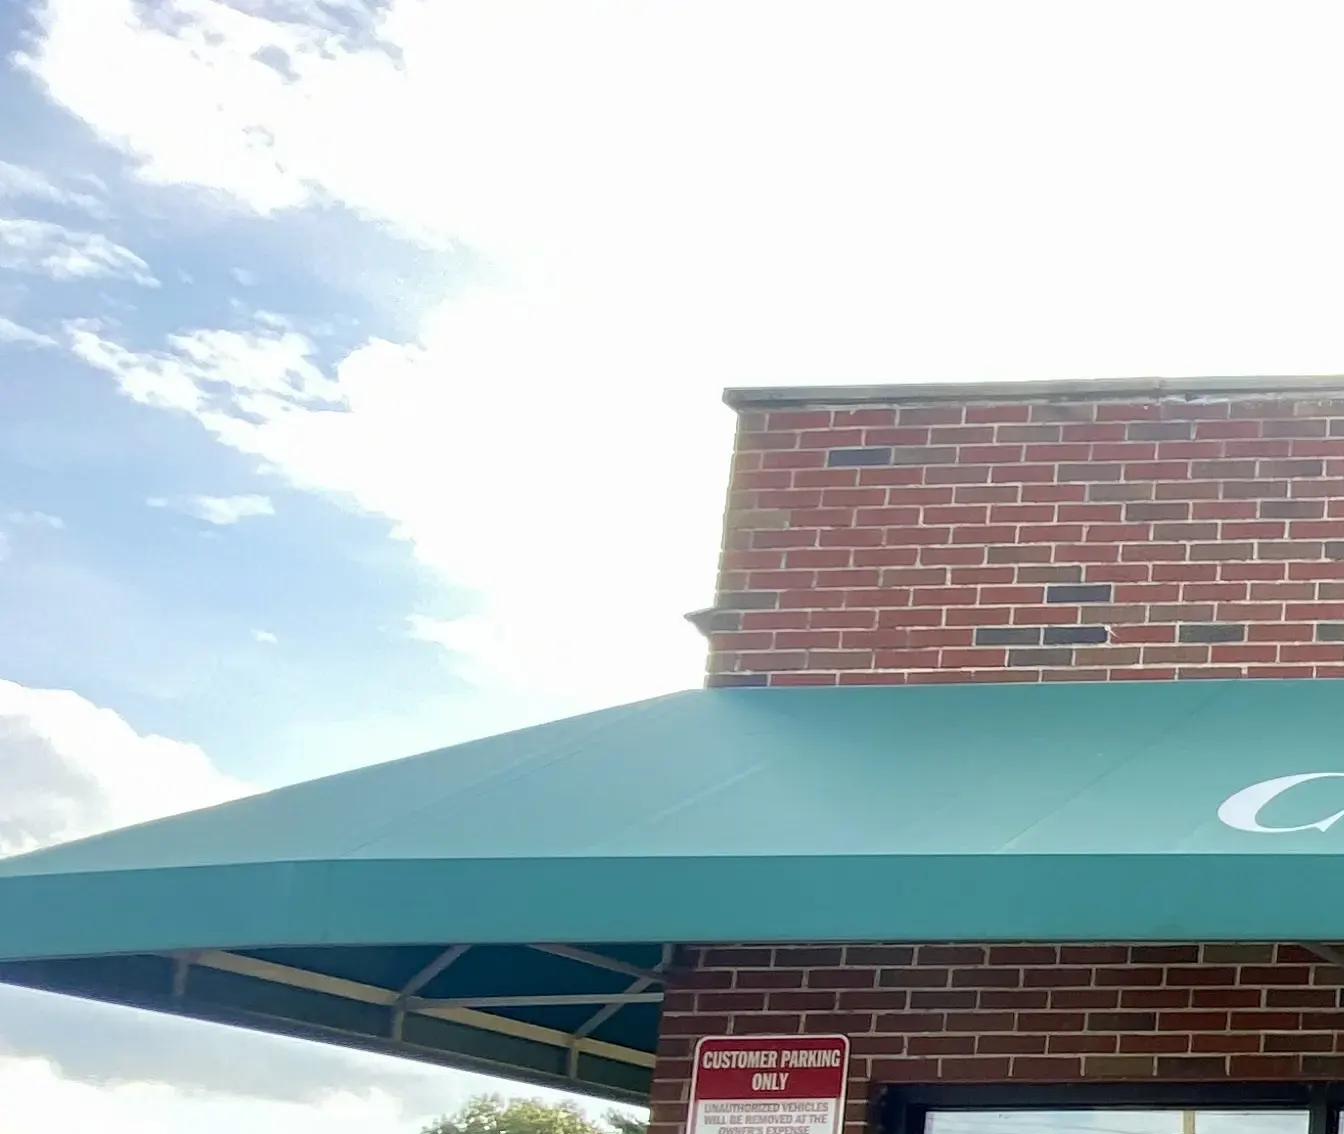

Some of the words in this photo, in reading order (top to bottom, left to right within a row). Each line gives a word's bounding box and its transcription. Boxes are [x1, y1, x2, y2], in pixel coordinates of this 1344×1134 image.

[703, 1050, 778, 1069] CUSTOMER
[781, 1049, 841, 1068] PARKING
[752, 1072, 789, 1091] ONLY
[704, 1103, 780, 1113] UNAUTHORIZED
[782, 1102, 829, 1113] VEHICLES
[704, 1115, 727, 1125] WILL
[729, 1115, 743, 1125] BE
[745, 1114, 793, 1125] REMOVED
[795, 1114, 808, 1124] AT
[808, 1113, 828, 1124] THE
